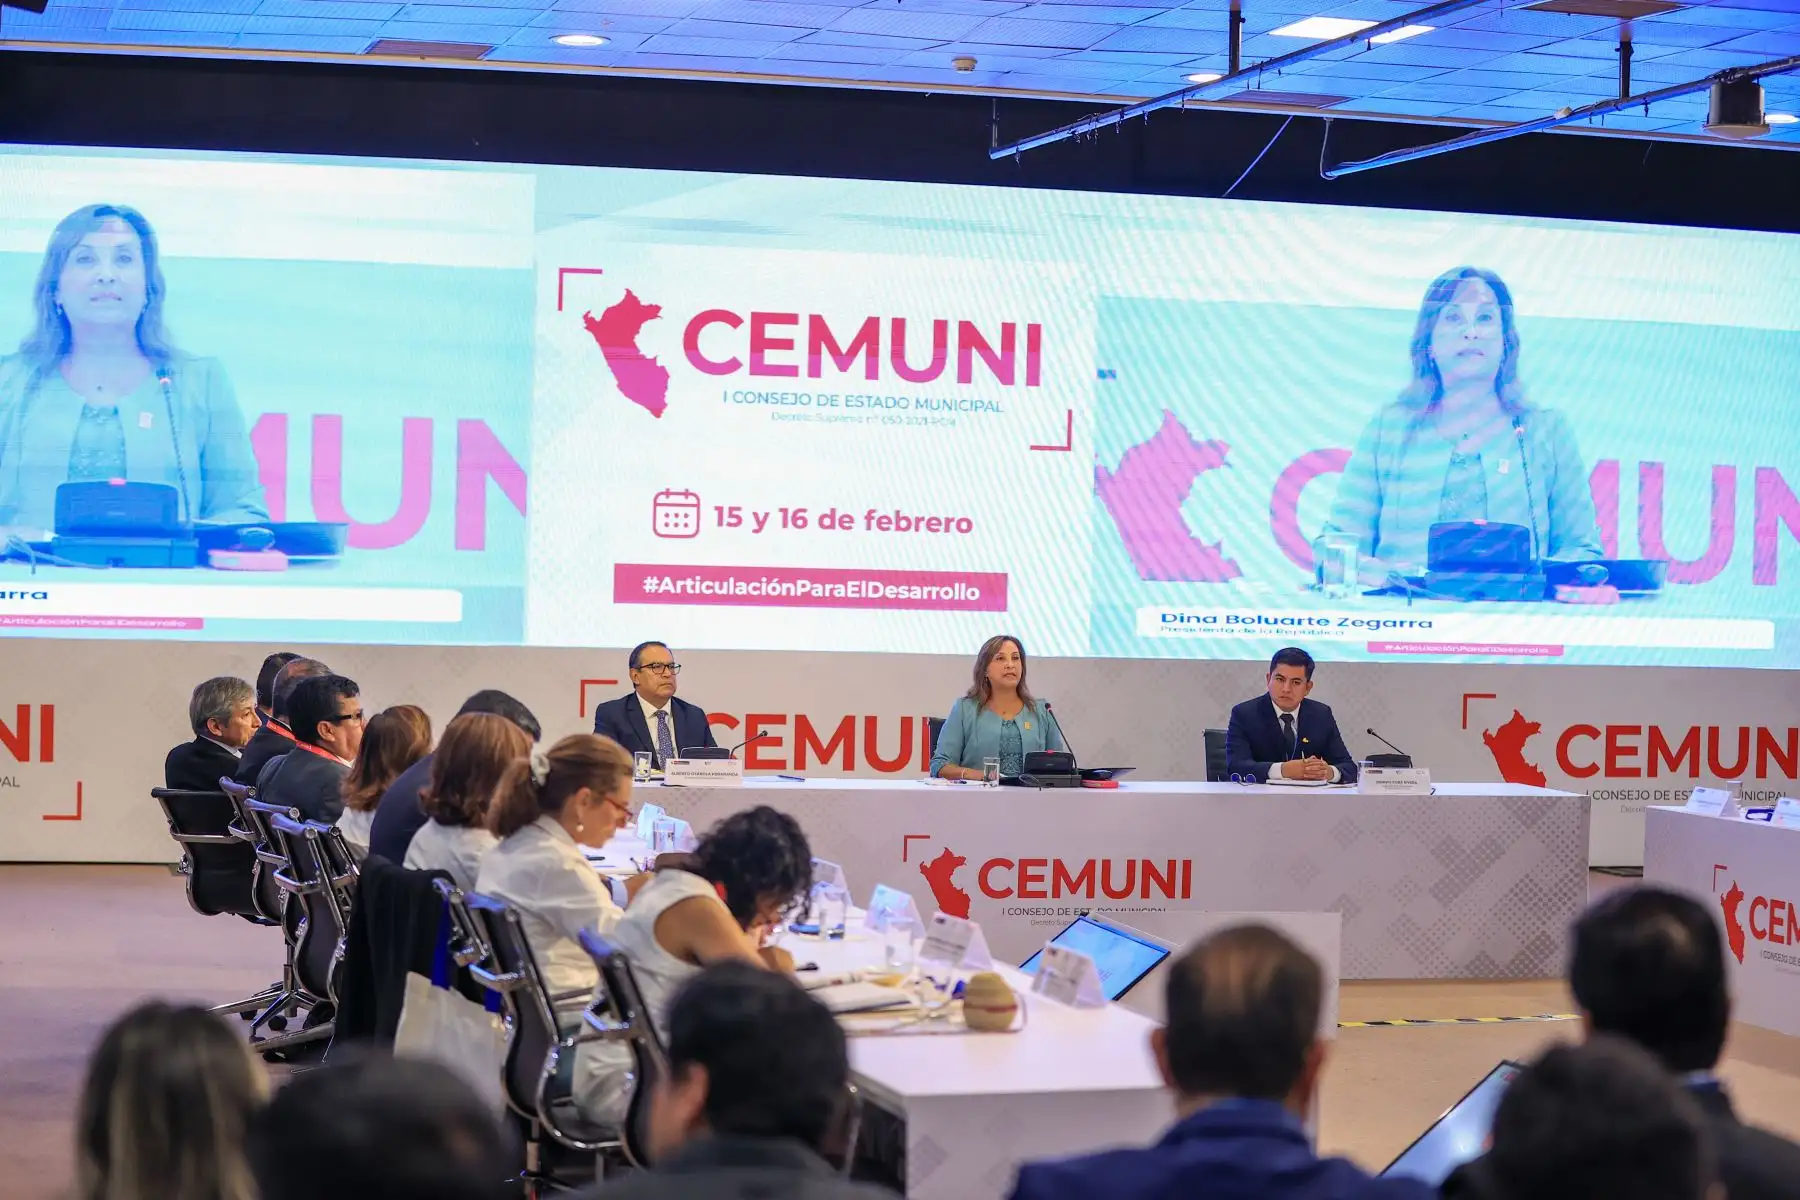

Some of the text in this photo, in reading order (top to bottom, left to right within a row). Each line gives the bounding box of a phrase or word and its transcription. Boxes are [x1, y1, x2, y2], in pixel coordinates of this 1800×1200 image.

[683, 309, 1042, 387] CEMUNI
[723, 390, 1005, 413] I CONSEJO DE ESTADO MUNICIPAL
[250, 412, 527, 550] UN
[714, 505, 974, 534] 15 y 16 de febrero
[1270, 448, 1800, 586] CUN
[643, 574, 981, 602] #ArticulaciónParaElDesarrollo
[1161, 613, 1433, 631] Dina Boluarte Zegarra
[706, 712, 930, 773] EMU
[1556, 724, 1799, 780] CEMUN
[1592, 790, 1650, 801] CONSEJO
[1654, 790, 1670, 801] DE
[978, 857, 1192, 900] CEMUNI
[1008, 907, 1055, 916] CONSEJO
[1057, 907, 1070, 916] DE
